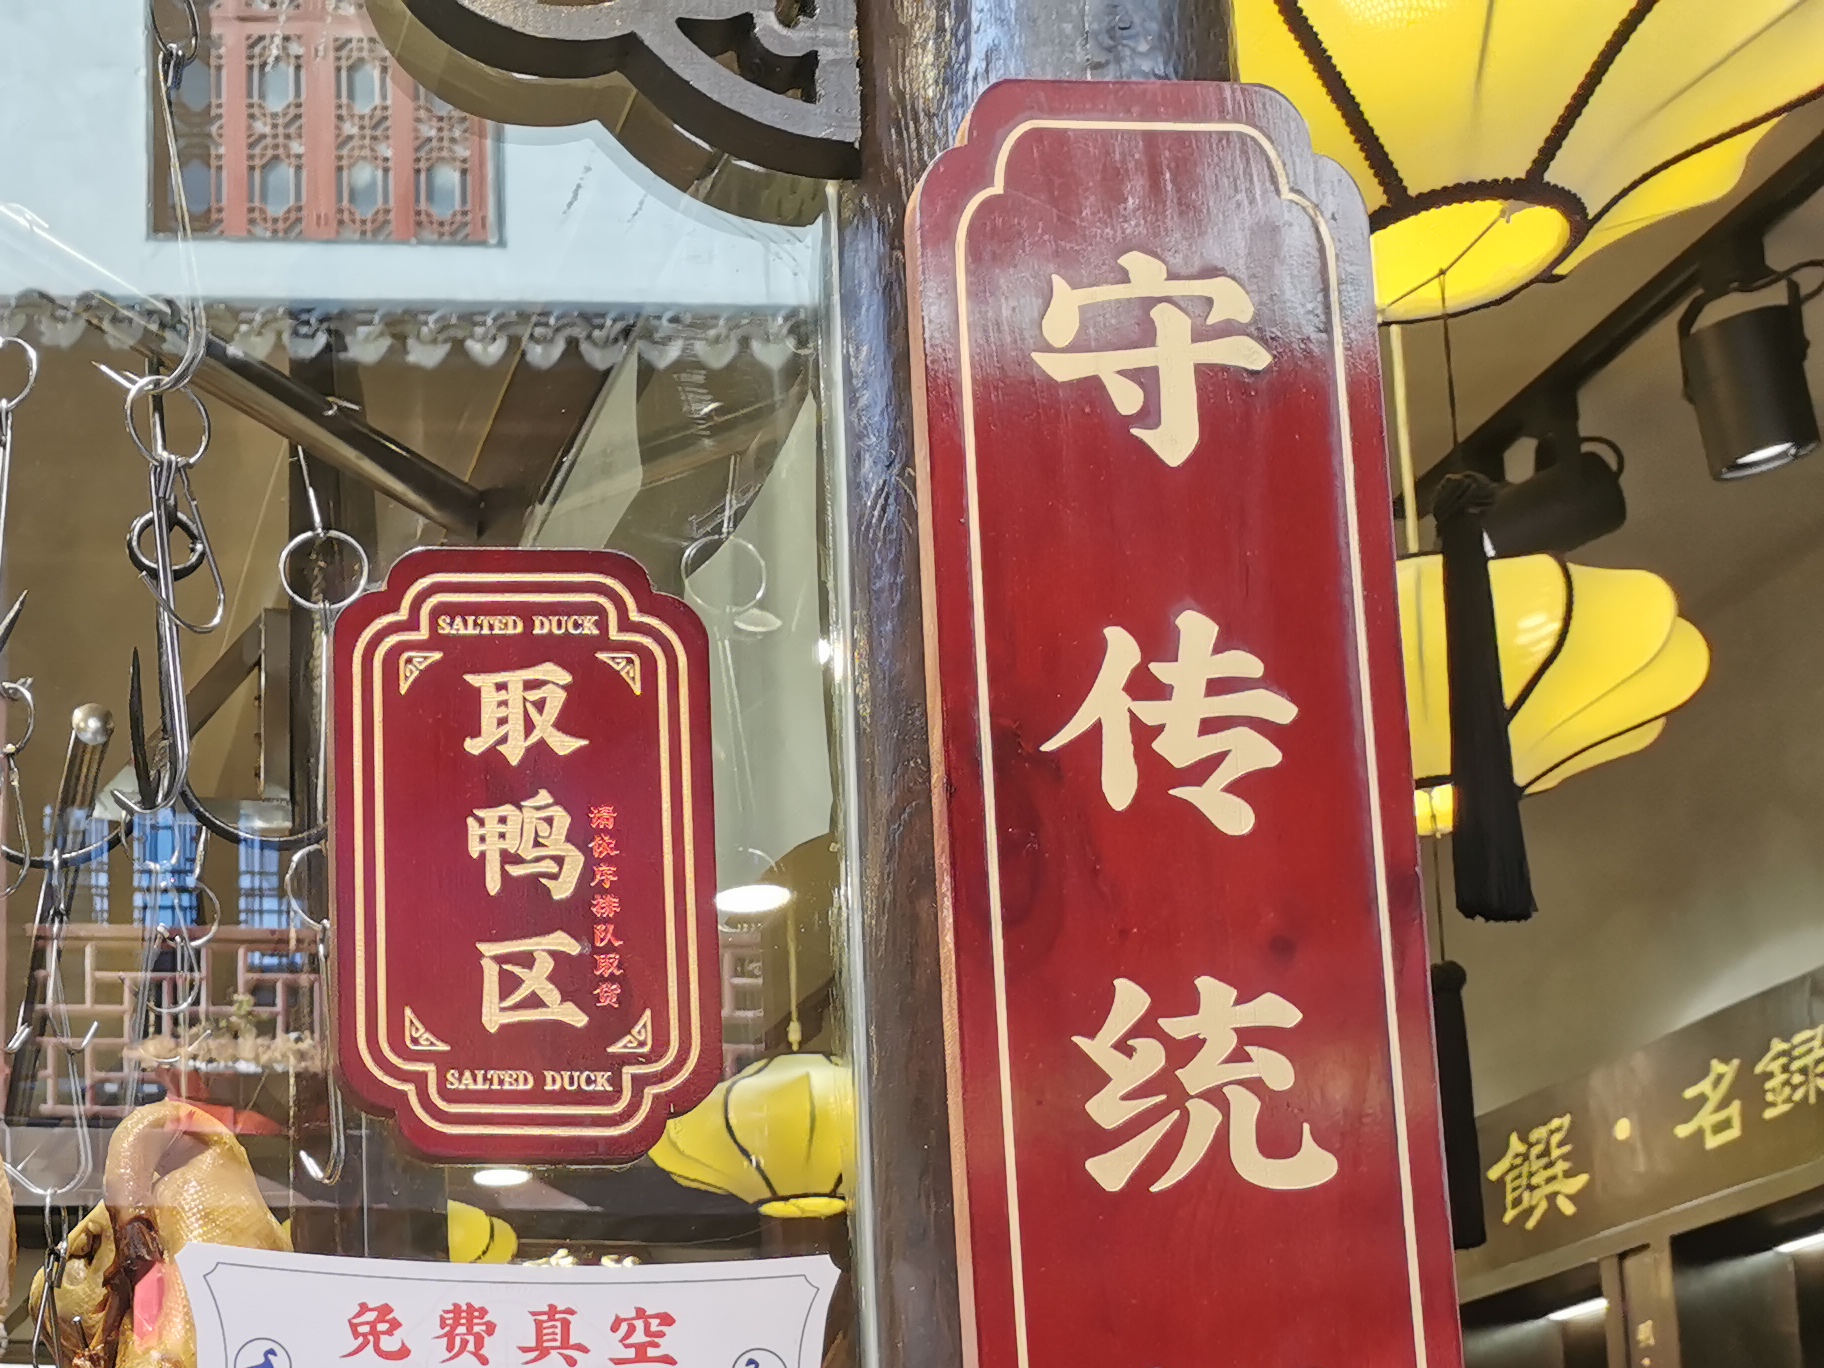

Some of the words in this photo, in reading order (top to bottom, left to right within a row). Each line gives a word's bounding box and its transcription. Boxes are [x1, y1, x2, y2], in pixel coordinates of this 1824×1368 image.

[437, 615, 524, 634] SALTED
[532, 615, 601, 635] DUCK
[462, 661, 590, 1033] 取鸭区
[588, 804, 624, 1009] 请依序排队取货
[446, 1068, 534, 1089] SALTED
[543, 1070, 613, 1091] DUCK
[339, 1301, 679, 1368] 免费真空
